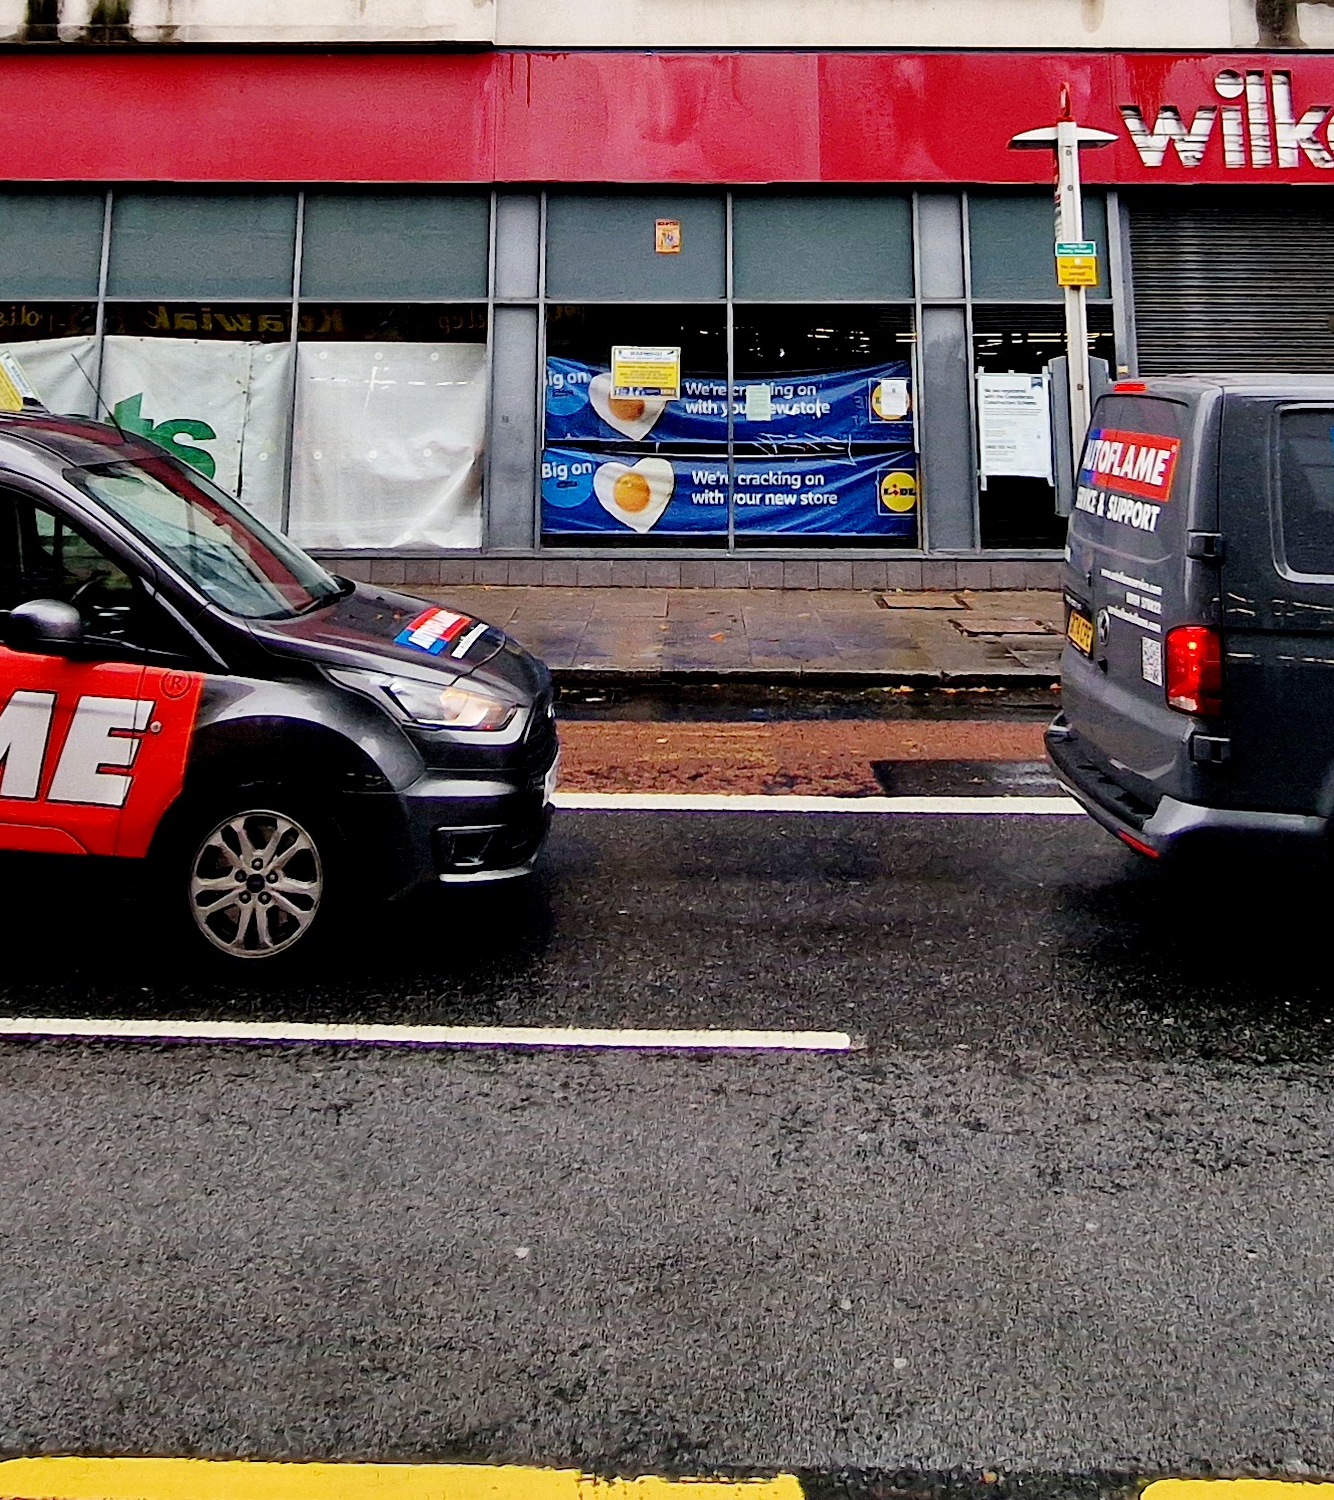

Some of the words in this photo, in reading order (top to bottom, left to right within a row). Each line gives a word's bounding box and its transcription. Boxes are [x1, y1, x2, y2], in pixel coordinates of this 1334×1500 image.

[547, 370, 565, 389] ig
[566, 371, 588, 384] on
[685, 381, 727, 396] We're
[732, 381, 794, 400] cring
[797, 385, 817, 396] on
[685, 399, 717, 415] with
[542, 462, 568, 481] Big
[571, 461, 593, 476] on
[1080, 439, 1172, 487] AUTOFLAME
[737, 470, 802, 490] cracking
[805, 474, 825, 486] on
[691, 489, 724, 505] with
[764, 493, 798, 506] new
[800, 492, 839, 506] store
[1106, 495, 1162, 533] SUPPORT
